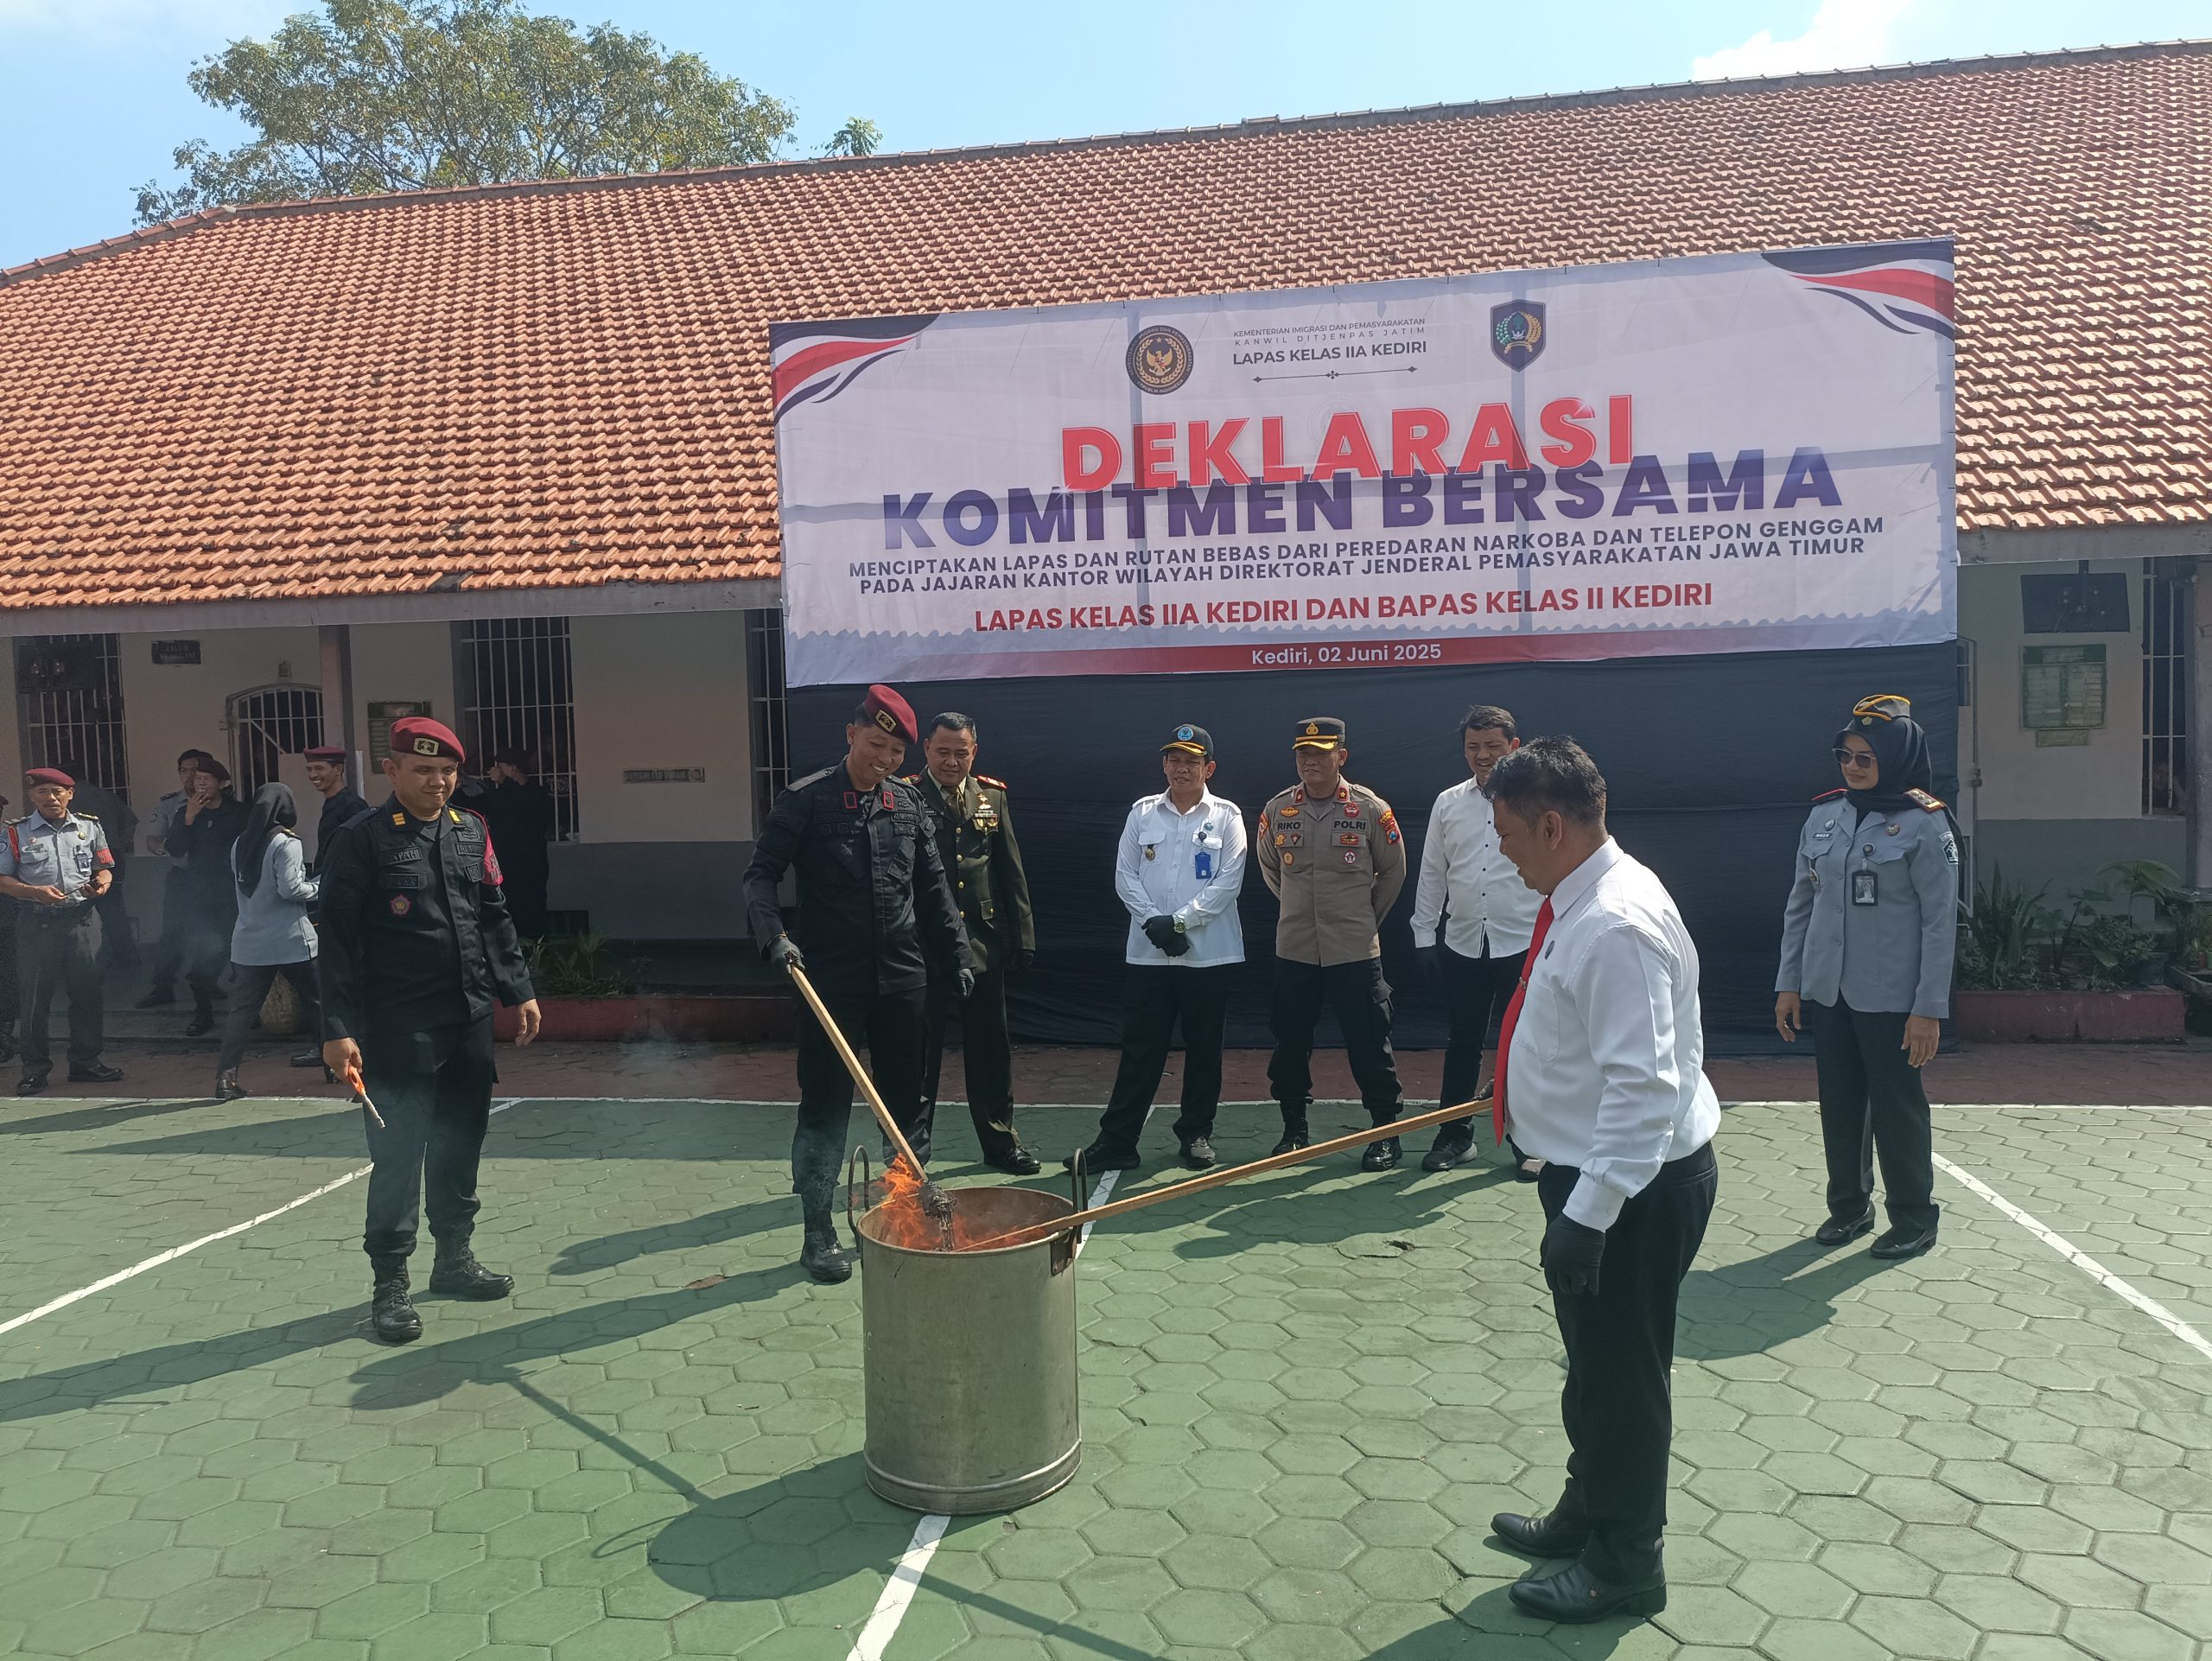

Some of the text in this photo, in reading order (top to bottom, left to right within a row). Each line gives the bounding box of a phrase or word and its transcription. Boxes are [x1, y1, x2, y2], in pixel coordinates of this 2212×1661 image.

[1234, 318, 1425, 337] KEMENTERIAN IMIGRASI DAN PEMASYARAKATAN
[1235, 327, 1425, 346] KANWIL DITJENPAS JATIM
[1233, 340, 1427, 365] LAPAS KELAS IIA KEDIRI
[1061, 394, 1633, 493] DEKLARASI
[883, 447, 1842, 550] KOMITMEN BERSAMA
[849, 517, 1884, 577] MENCIPTAKAN LAPAS DAN RUTAN BEBAS DARI PEREDARAN NARKOBA DAN TELEPON GENGGAM
[861, 538, 1865, 595] PADA JAJARAN KANTOR WILAYAH DIREKTORAT JENDERAL PEMASYARAKATAN JAWA TIMUR
[976, 582, 1712, 632] LAPAS KELAS IIA KEDIRI DAN BAPAS KELAS II KEDIRI
[1252, 643, 1441, 666] Kediri, 02 Juni 2025
[1277, 822, 1301, 830] RIKO
[1334, 820, 1366, 830] POLRI
